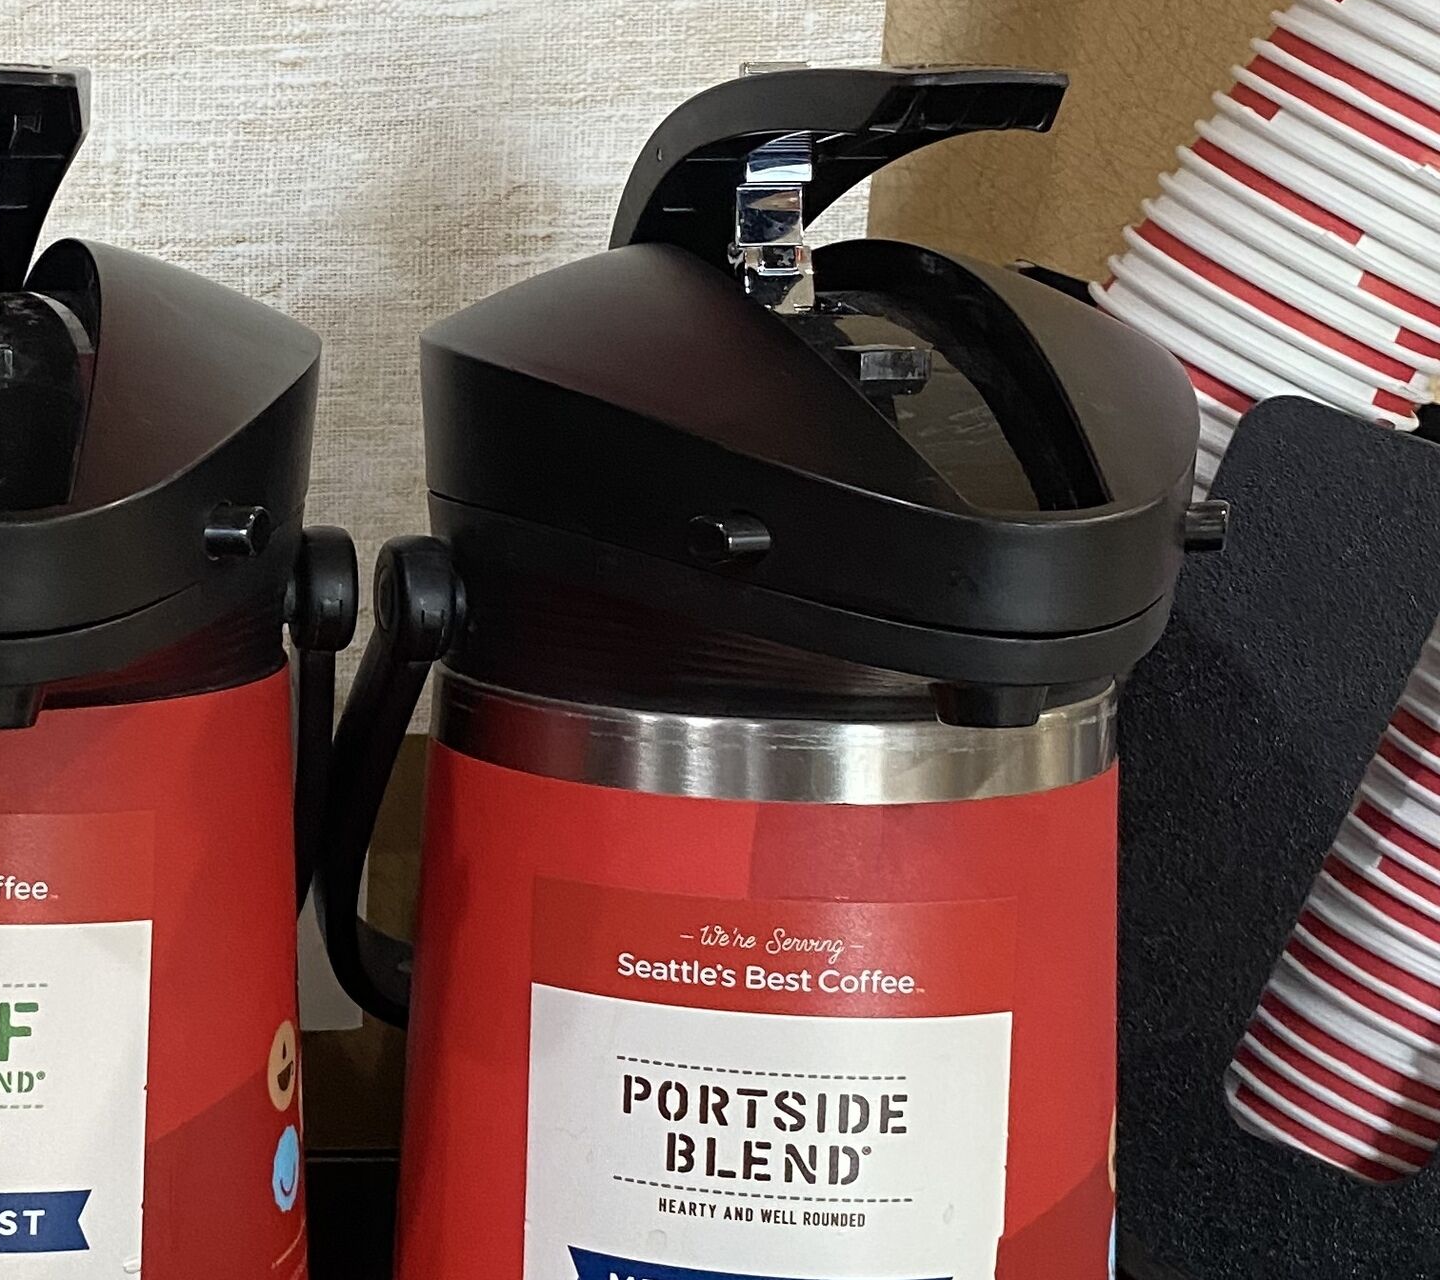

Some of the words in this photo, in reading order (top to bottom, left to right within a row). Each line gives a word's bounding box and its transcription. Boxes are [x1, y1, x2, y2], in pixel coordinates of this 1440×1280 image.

[700, 925, 756, 949] We're
[765, 928, 845, 964] Serving
[617, 952, 736, 988] Seattle's
[745, 966, 812, 992] Best
[818, 968, 915, 993] Coffee
[623, 1075, 908, 1134] PORTSIDE
[659, 1197, 717, 1218] HEARTY
[724, 1206, 754, 1222] AND
[761, 1209, 796, 1225] WELL
[803, 1212, 866, 1227] ROUNDED
